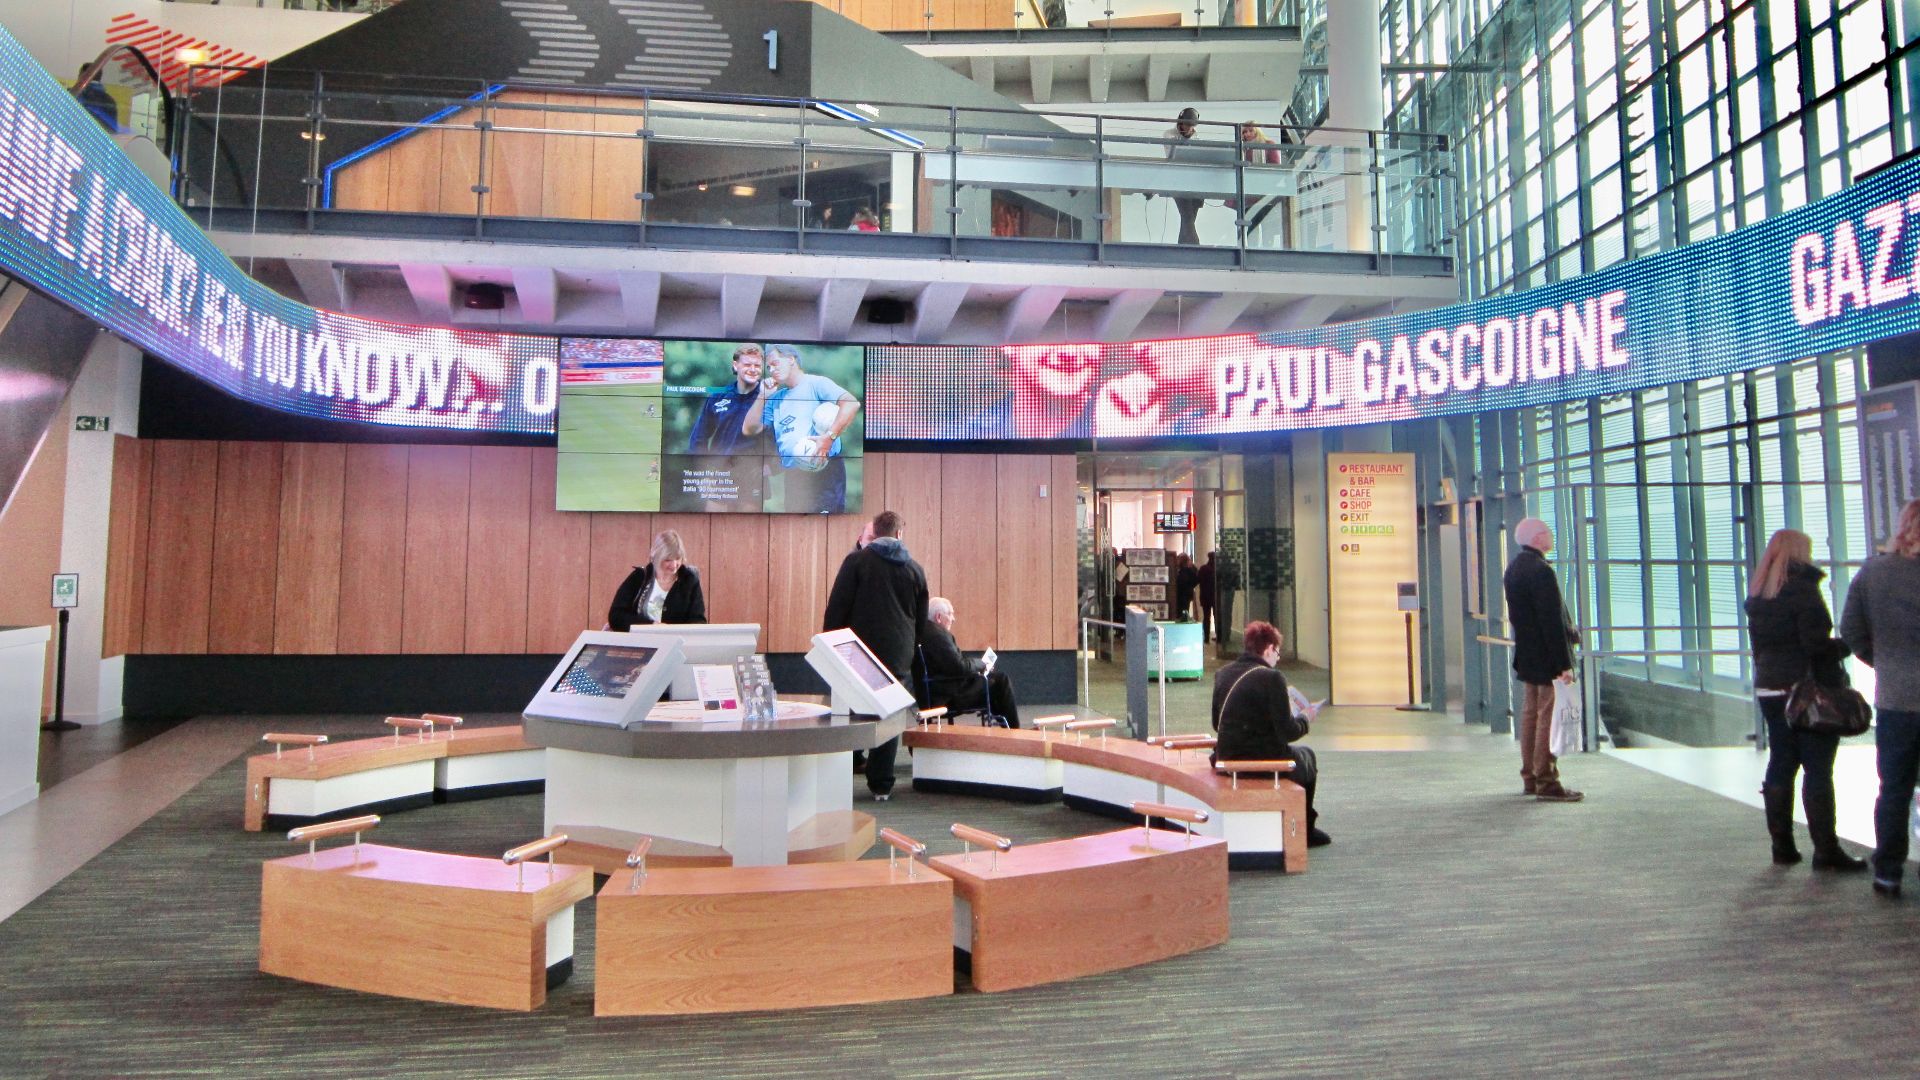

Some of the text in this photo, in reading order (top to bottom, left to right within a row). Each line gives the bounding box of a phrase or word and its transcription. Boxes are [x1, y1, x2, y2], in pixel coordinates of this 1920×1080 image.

[763, 30, 778, 70] 1
[251, 309, 298, 388] YOU
[1217, 289, 1630, 417] PAUL GASCOIGNE
[1349, 464, 1404, 474] RESTAURANT
[1349, 477, 1375, 486] & BAR
[1349, 489, 1371, 498] CAFE
[1350, 501, 1372, 510] SHOP
[1350, 513, 1369, 522] EXIT
